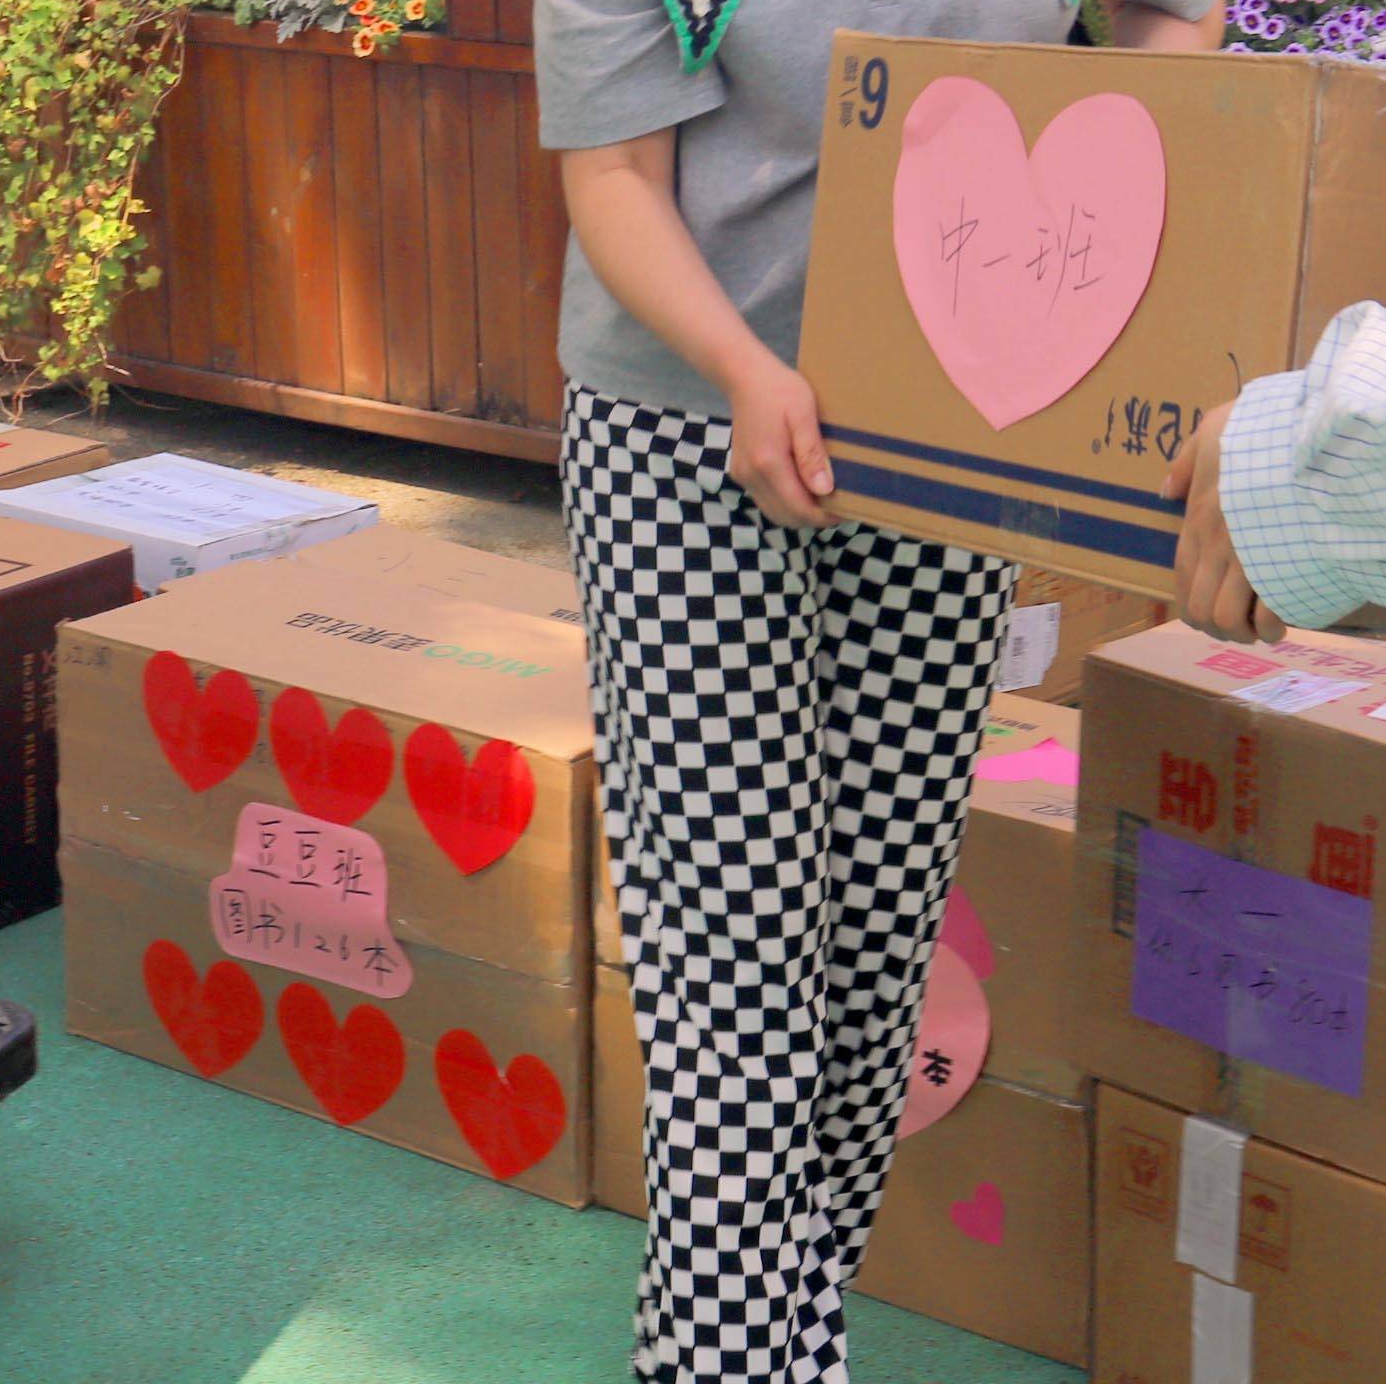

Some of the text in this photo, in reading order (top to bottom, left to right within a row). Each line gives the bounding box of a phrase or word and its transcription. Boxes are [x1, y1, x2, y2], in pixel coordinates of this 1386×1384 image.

[937, 195, 1107, 318] 中一班
[247, 819, 373, 902] 豆豆班
